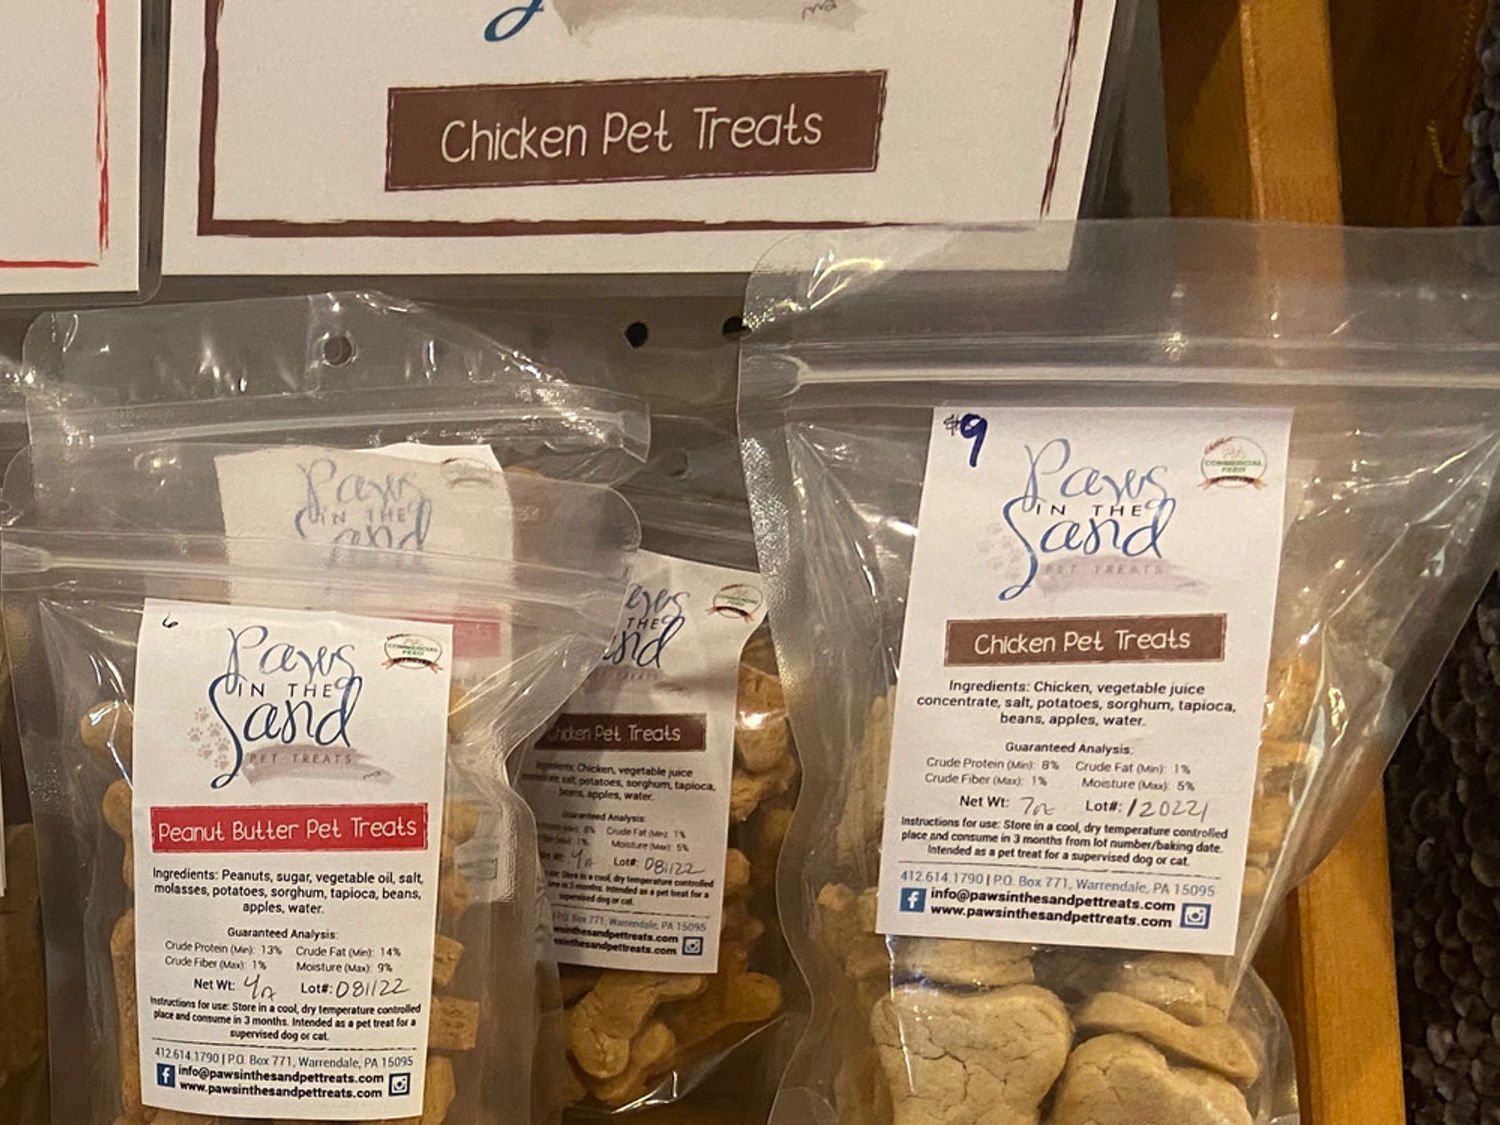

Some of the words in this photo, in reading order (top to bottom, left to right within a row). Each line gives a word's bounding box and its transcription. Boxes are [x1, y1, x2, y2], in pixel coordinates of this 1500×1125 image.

[441, 117, 588, 164] Chicken
[604, 110, 672, 155] Pet
[692, 103, 823, 148] Treats
[944, 413, 988, 467] $9
[1024, 438, 1168, 513] Paws
[1036, 504, 1067, 515] IN
[1092, 504, 1143, 517] THE
[999, 497, 1176, 600] Sand
[974, 633, 1055, 656] Chicken
[1063, 631, 1104, 652] Pet
[1115, 629, 1190, 650] Treats
[227, 625, 358, 694] Paws
[238, 683, 265, 697] IN
[288, 683, 332, 698] THE
[949, 679, 1030, 694] Ingredients:
[1033, 680, 1093, 695] Chicken,
[1097, 682, 1166, 697] vegetable
[1169, 683, 1205, 697] juice
[916, 695, 1001, 709] concentrate,
[1004, 697, 1033, 709] salt,
[1037, 698, 1103, 711] potatoes,
[1107, 699, 1174, 712] sorghum,
[1178, 700, 1237, 714] tapioca,
[1000, 712, 1045, 726] beans,
[1049, 714, 1100, 727] apples,
[1103, 715, 1147, 727] water.
[209, 676, 362, 789] Sand
[594, 725, 621, 742] Pet
[628, 724, 681, 742] Treats
[1005, 741, 1075, 754] Guaranteed
[1078, 742, 1133, 756] Analysis:
[252, 754, 276, 764] PET
[292, 754, 352, 764] TREATS
[1085, 801, 1122, 814] Lot#:
[158, 822, 225, 843] Peanut
[232, 820, 299, 840] Butter
[306, 818, 342, 839] Pet
[350, 817, 417, 837] Treats
[152, 867, 218, 881] Ingredients:
[222, 870, 274, 883] Peanuts,
[276, 872, 312, 884] sugar,
[316, 873, 374, 885] vegetable
[378, 873, 395, 885] oil,
[399, 874, 423, 885] salt,
[154, 883, 209, 896] molasses,
[212, 886, 267, 899] potatoes,
[271, 887, 327, 900] sorghum,
[330, 888, 378, 900] tapioca,
[382, 889, 421, 900] beans,
[930, 888, 1176, 912] info@pawsinthesandpettreats.com
[243, 903, 285, 914] apples,
[288, 902, 324, 914] water.
[930, 904, 1172, 929] www.pawsinthesandpettreats.com
[227, 927, 288, 939] Guaranteed
[291, 928, 338, 940] Analysis:
[194, 978, 214, 990] Net
[216, 979, 235, 991] Wt:
[301, 983, 333, 995] Lot#:
[155, 1047, 219, 1063] 412.614.1790
[249, 1055, 269, 1065] Box
[273, 1055, 295, 1067] 771,
[298, 1057, 361, 1069] Warrendale,
[364, 1057, 378, 1067] PA
[382, 1056, 413, 1067] 15095
[178, 1065, 384, 1084] info@pawsinthesandpettreats.com
[179, 1080, 382, 1100] www.pawsinthesandpettreats.com
